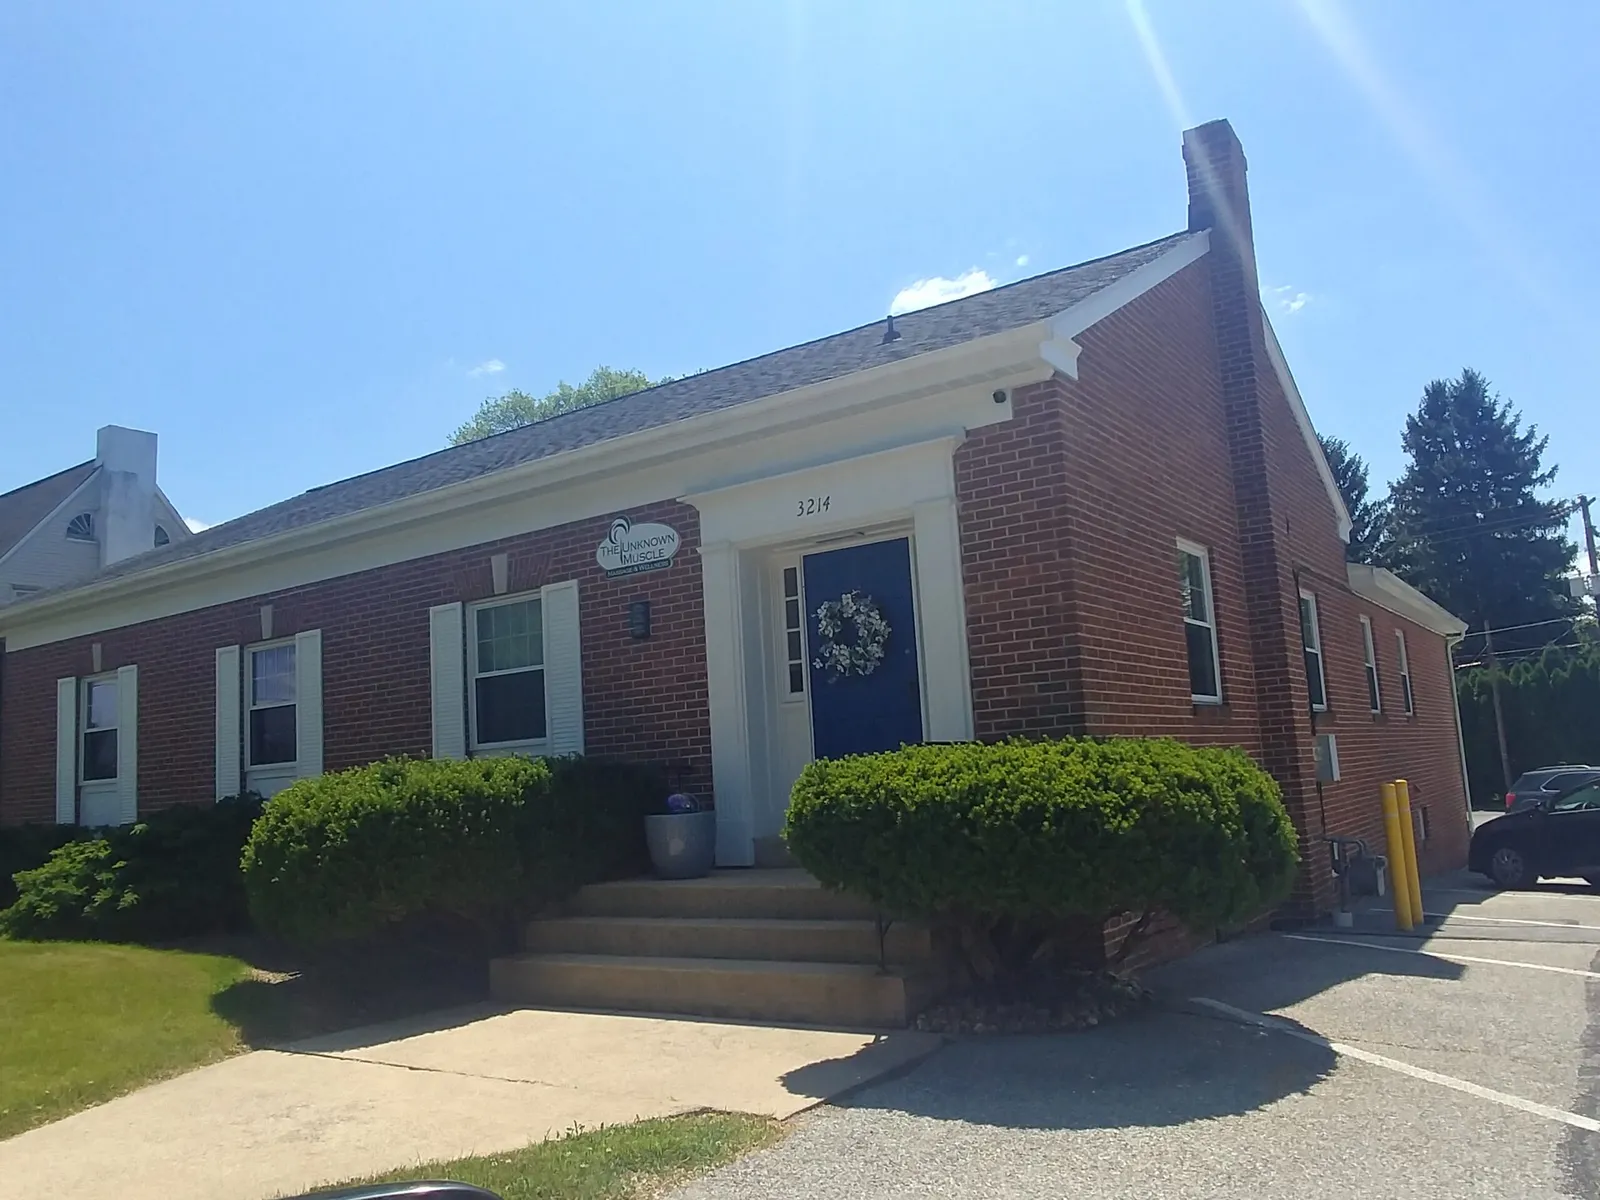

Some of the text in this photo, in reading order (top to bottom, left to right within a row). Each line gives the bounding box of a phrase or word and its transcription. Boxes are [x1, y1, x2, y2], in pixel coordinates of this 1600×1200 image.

[797, 496, 830, 517] 3214
[600, 533, 675, 558] THE UNKNOWN
[623, 549, 665, 565] MUSCLE
